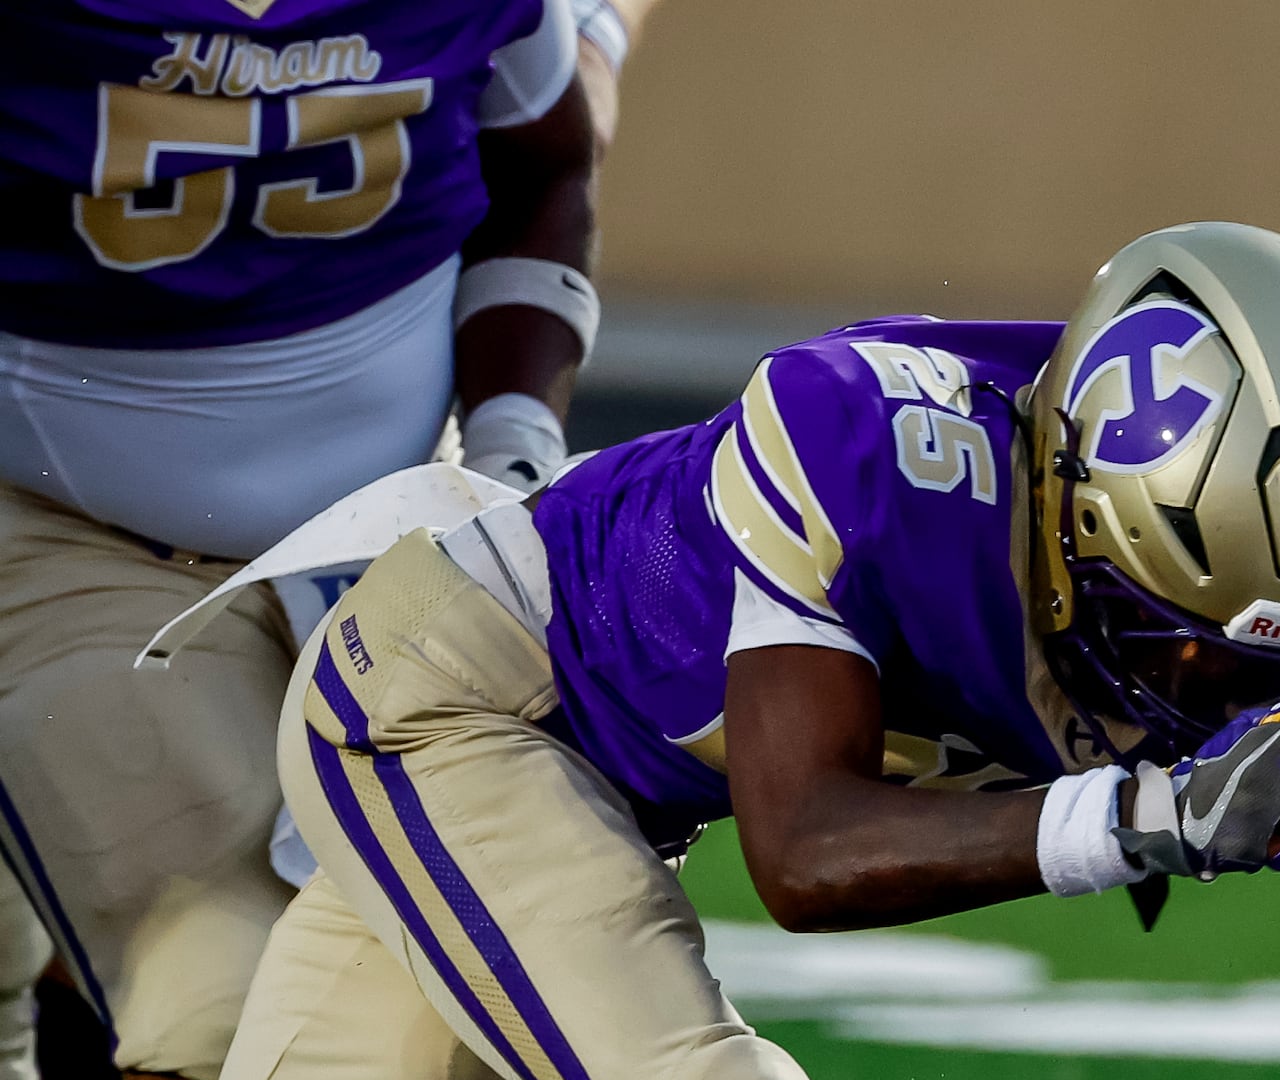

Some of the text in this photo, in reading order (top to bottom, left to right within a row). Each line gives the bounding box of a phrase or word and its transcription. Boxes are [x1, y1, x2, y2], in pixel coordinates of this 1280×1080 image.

[139, 33, 381, 97] Hiram
[73, 78, 434, 272] 55
[849, 341, 997, 506] 25
[340, 614, 374, 675] HORNETS
